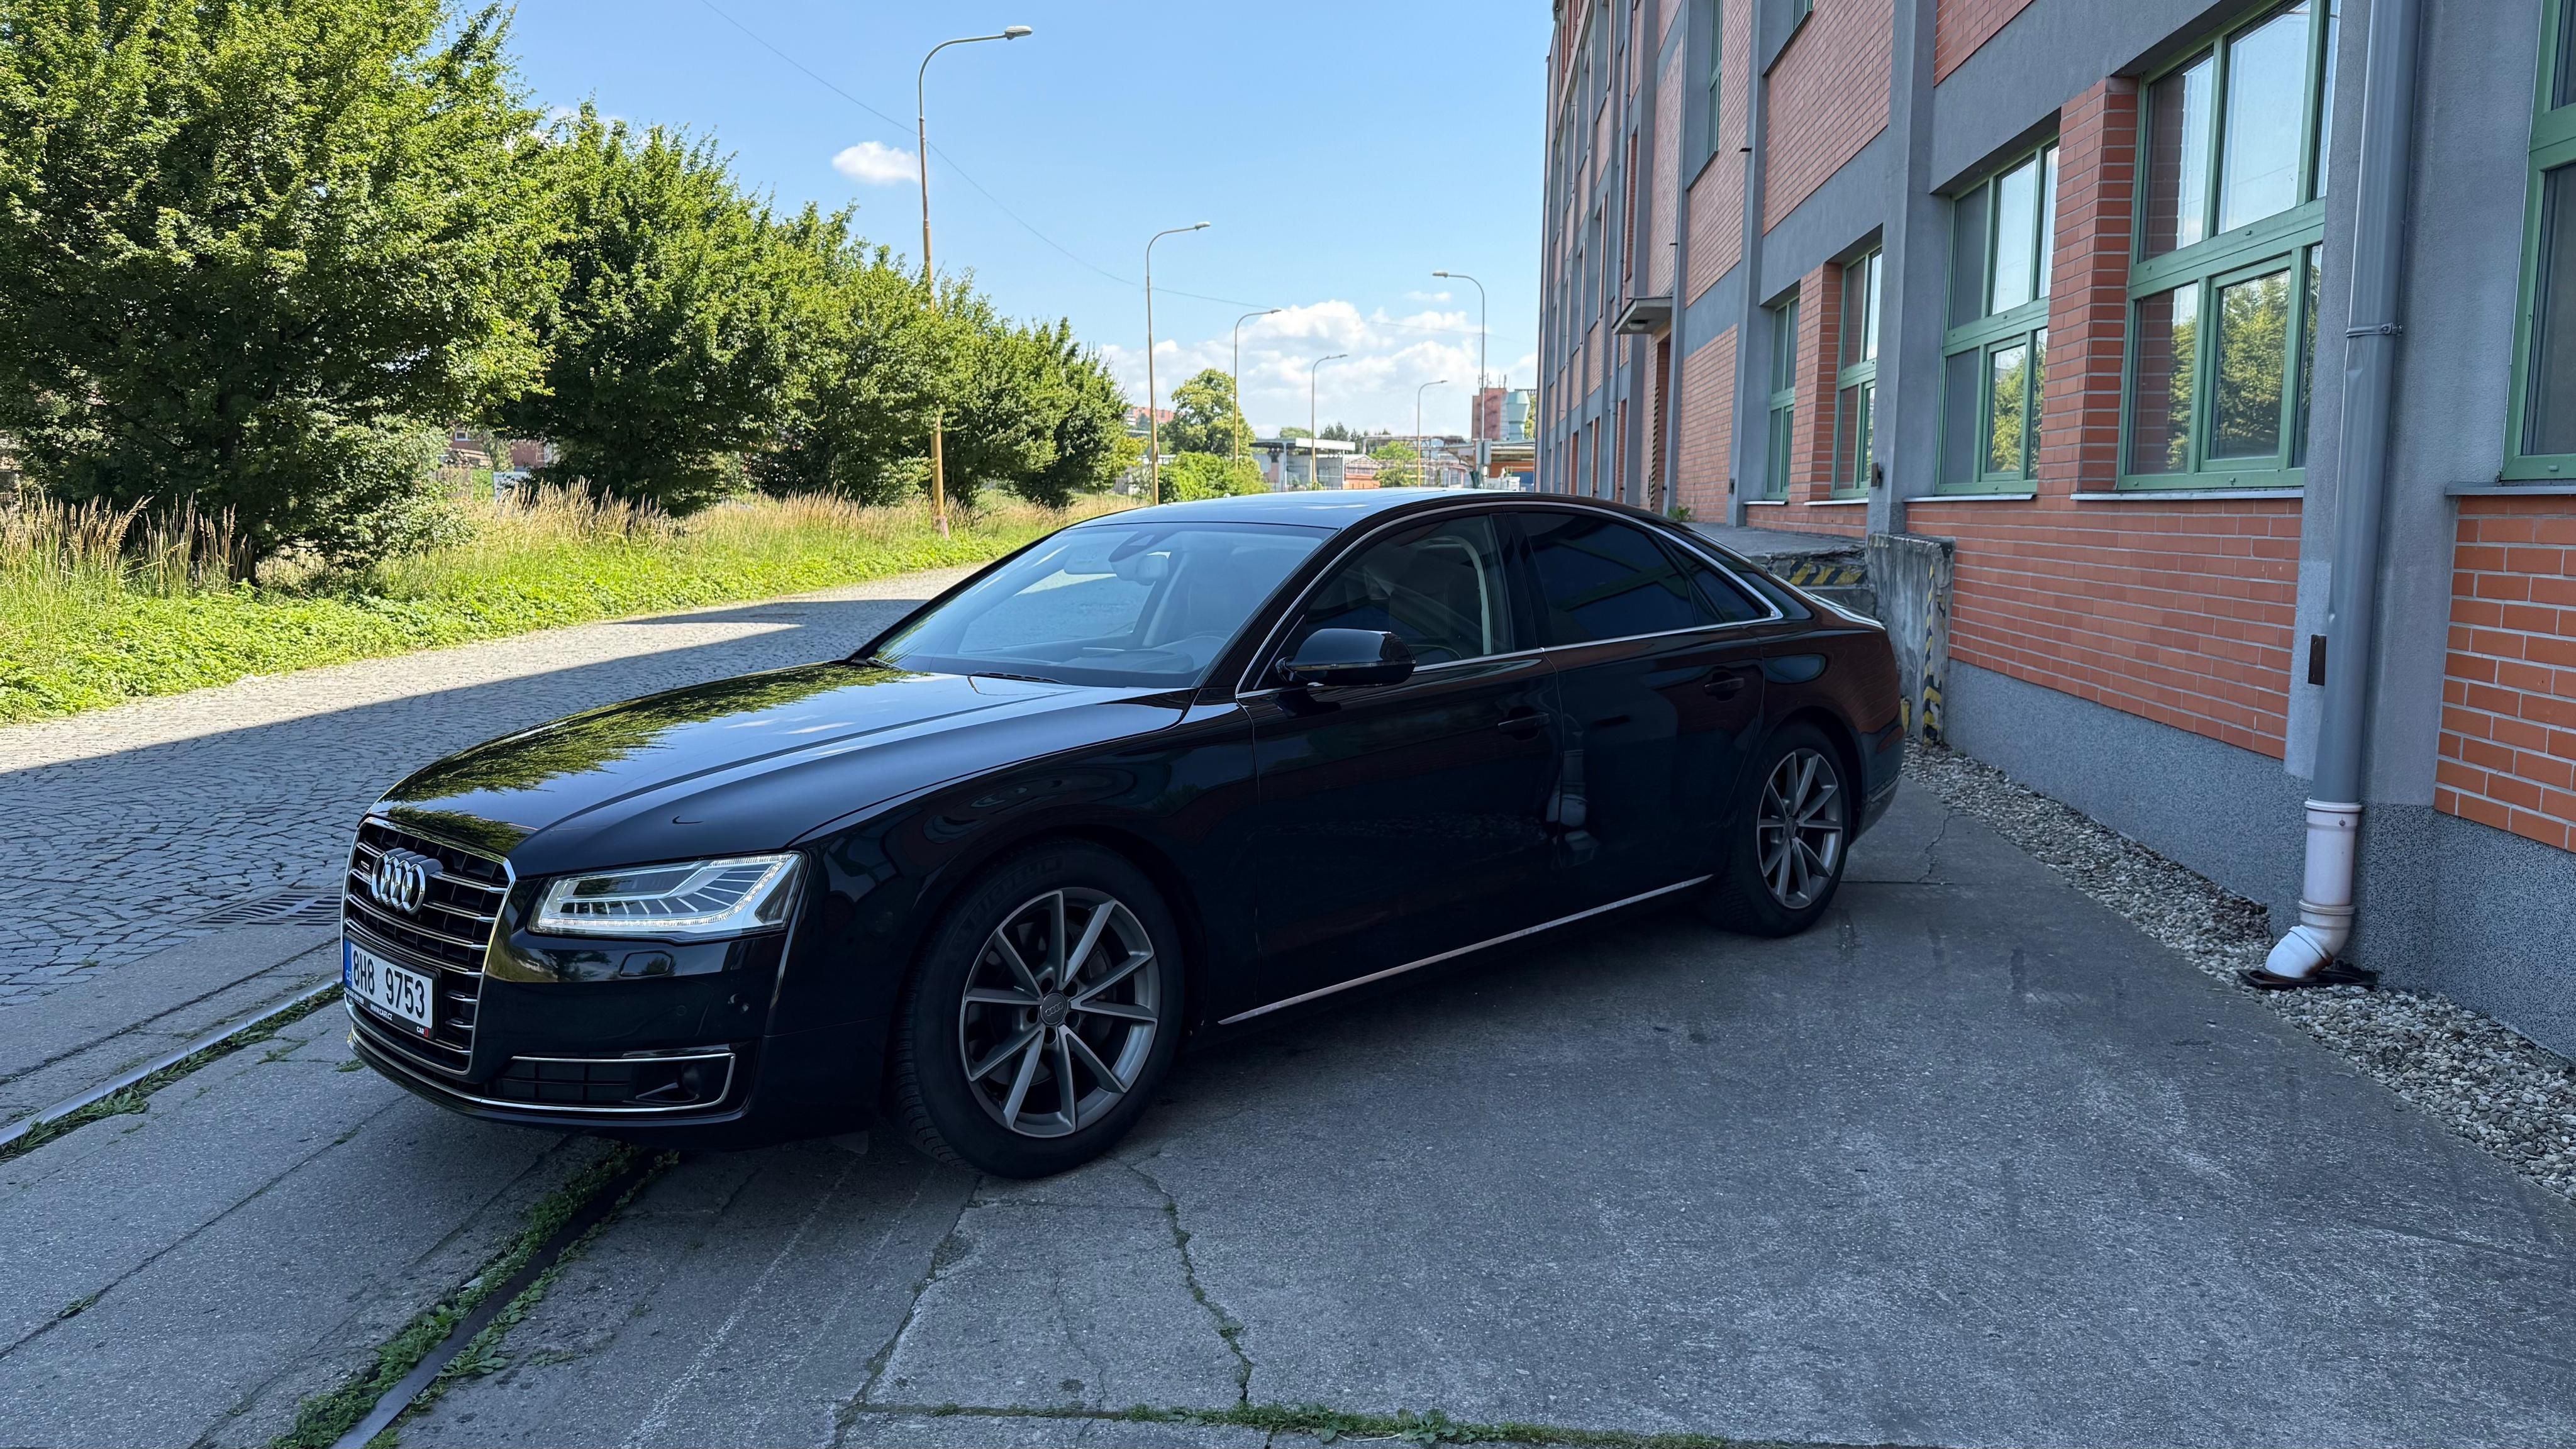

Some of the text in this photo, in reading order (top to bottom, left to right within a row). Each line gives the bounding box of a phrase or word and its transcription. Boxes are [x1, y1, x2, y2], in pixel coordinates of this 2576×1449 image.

[346, 969, 352, 981] CZ
[353, 950, 425, 1019] 8H8 9753
